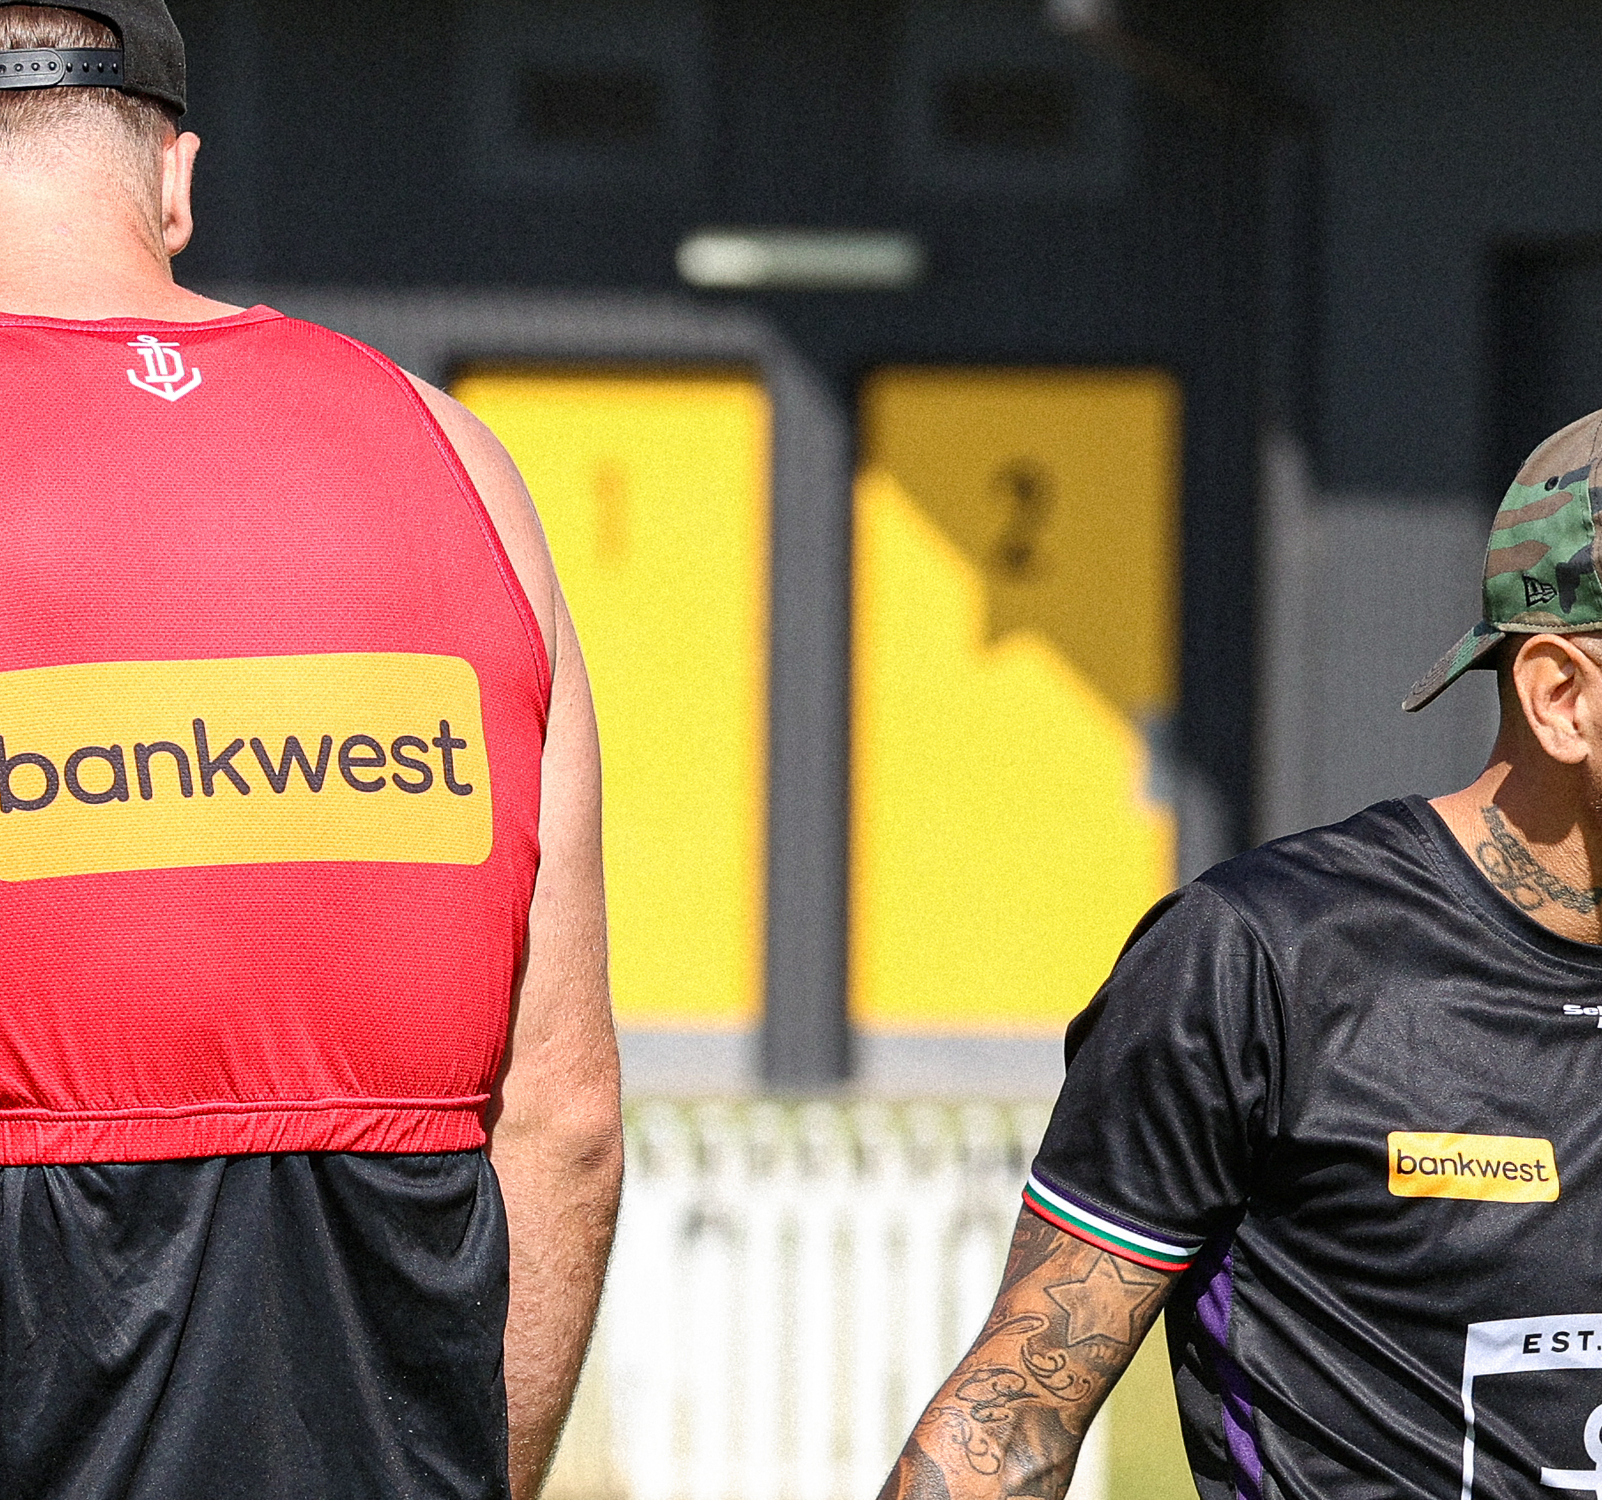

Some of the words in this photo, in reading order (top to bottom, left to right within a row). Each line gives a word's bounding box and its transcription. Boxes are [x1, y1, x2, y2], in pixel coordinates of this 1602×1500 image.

[986, 457, 1054, 582] 2
[0, 717, 473, 814] bankwest
[1397, 1148, 1550, 1182] bankwest
[1522, 1330, 1602, 1354] EST.
